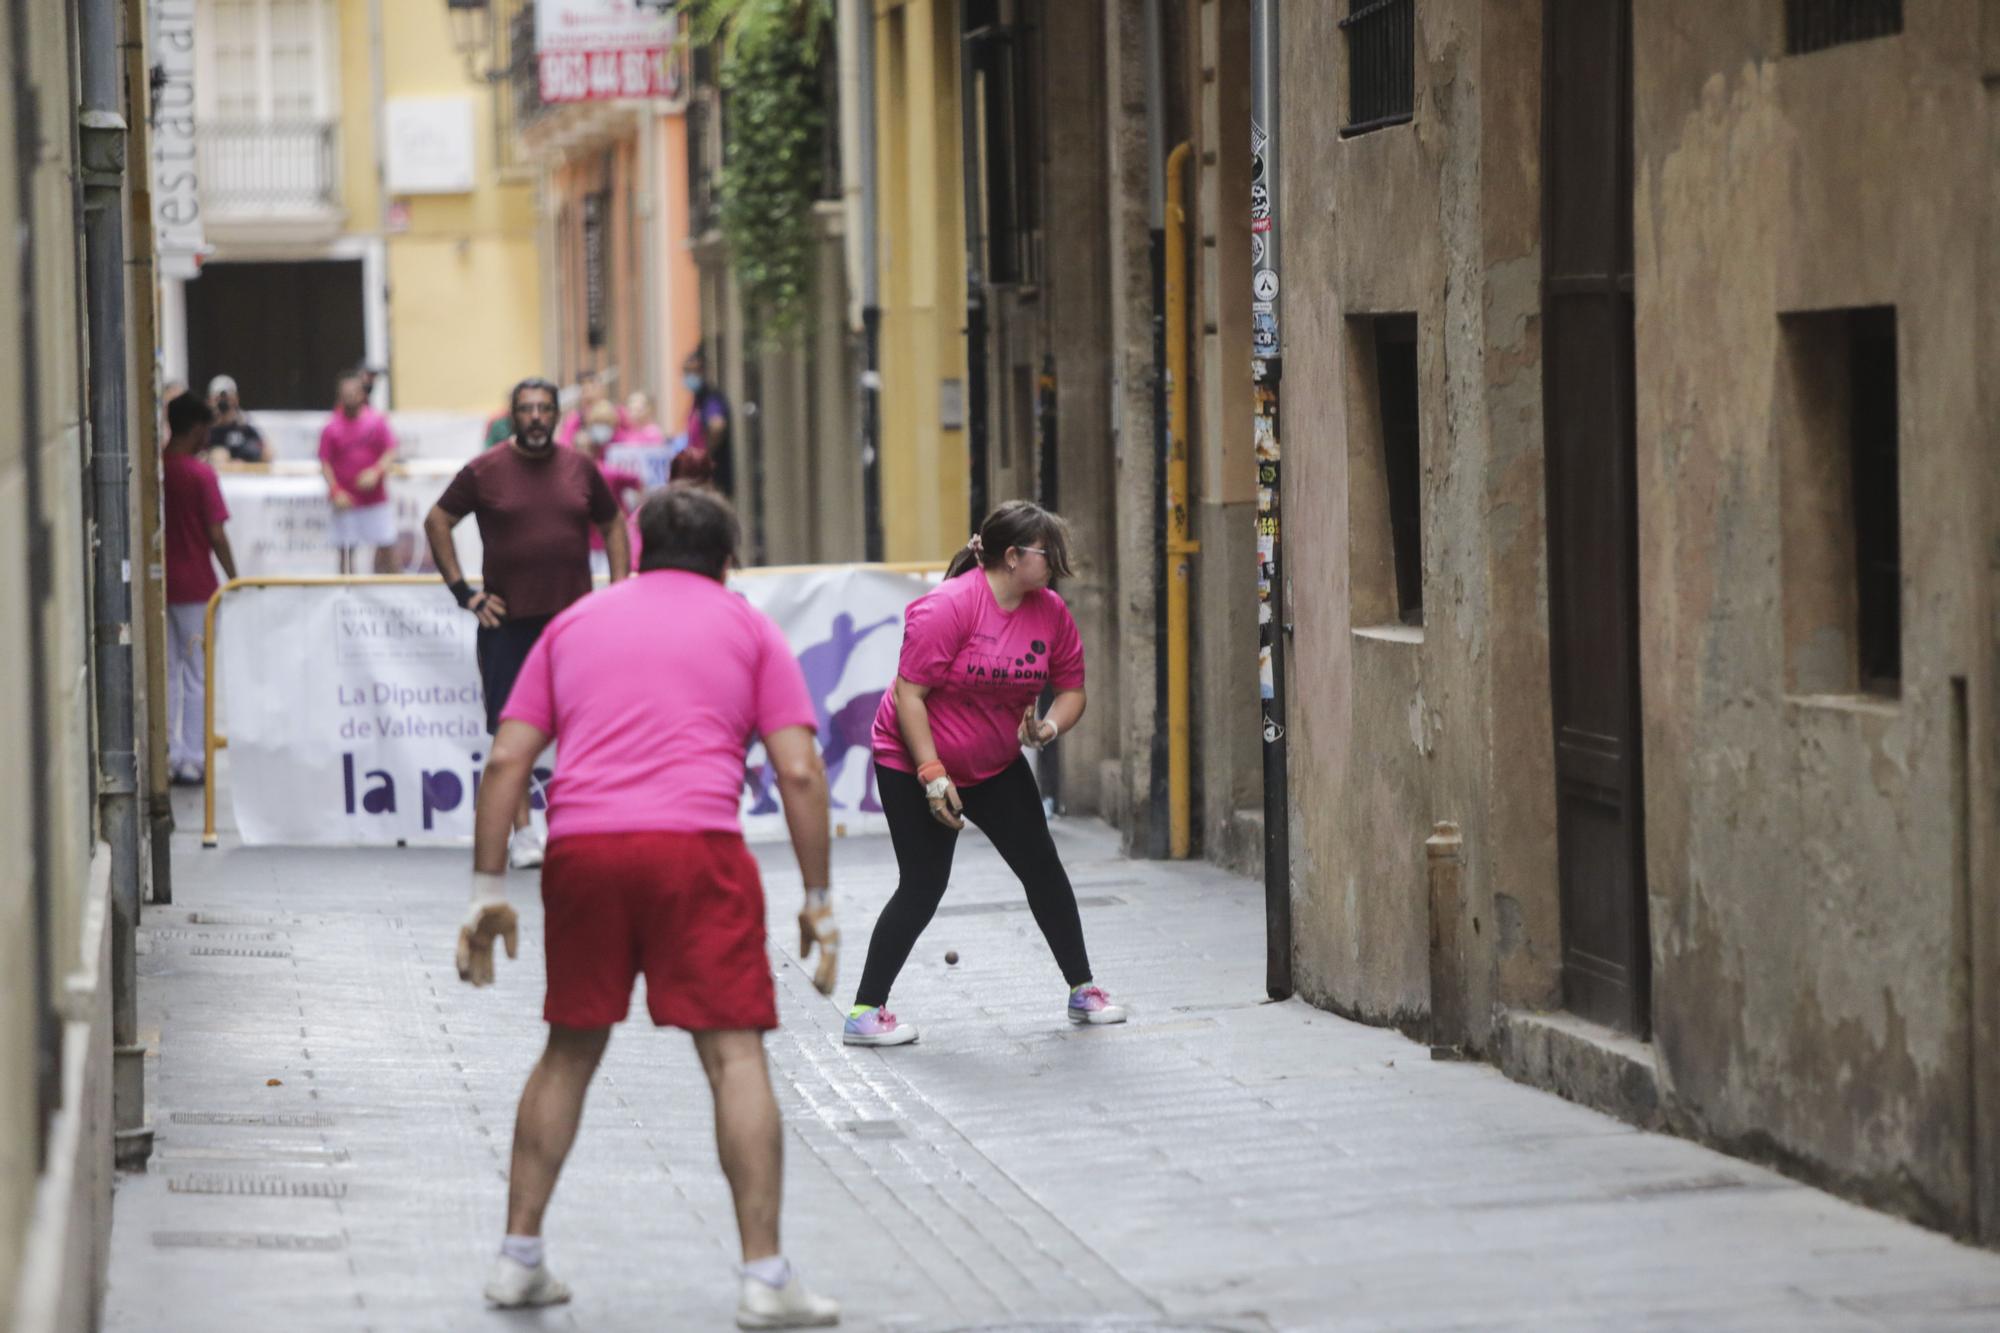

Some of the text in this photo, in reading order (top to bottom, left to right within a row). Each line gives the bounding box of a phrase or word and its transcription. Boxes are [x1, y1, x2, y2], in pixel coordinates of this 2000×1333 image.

[966, 663, 986, 677] VA
[338, 681, 484, 709] La Diputaci
[340, 713, 480, 740] de València
[342, 751, 483, 831] la pi
